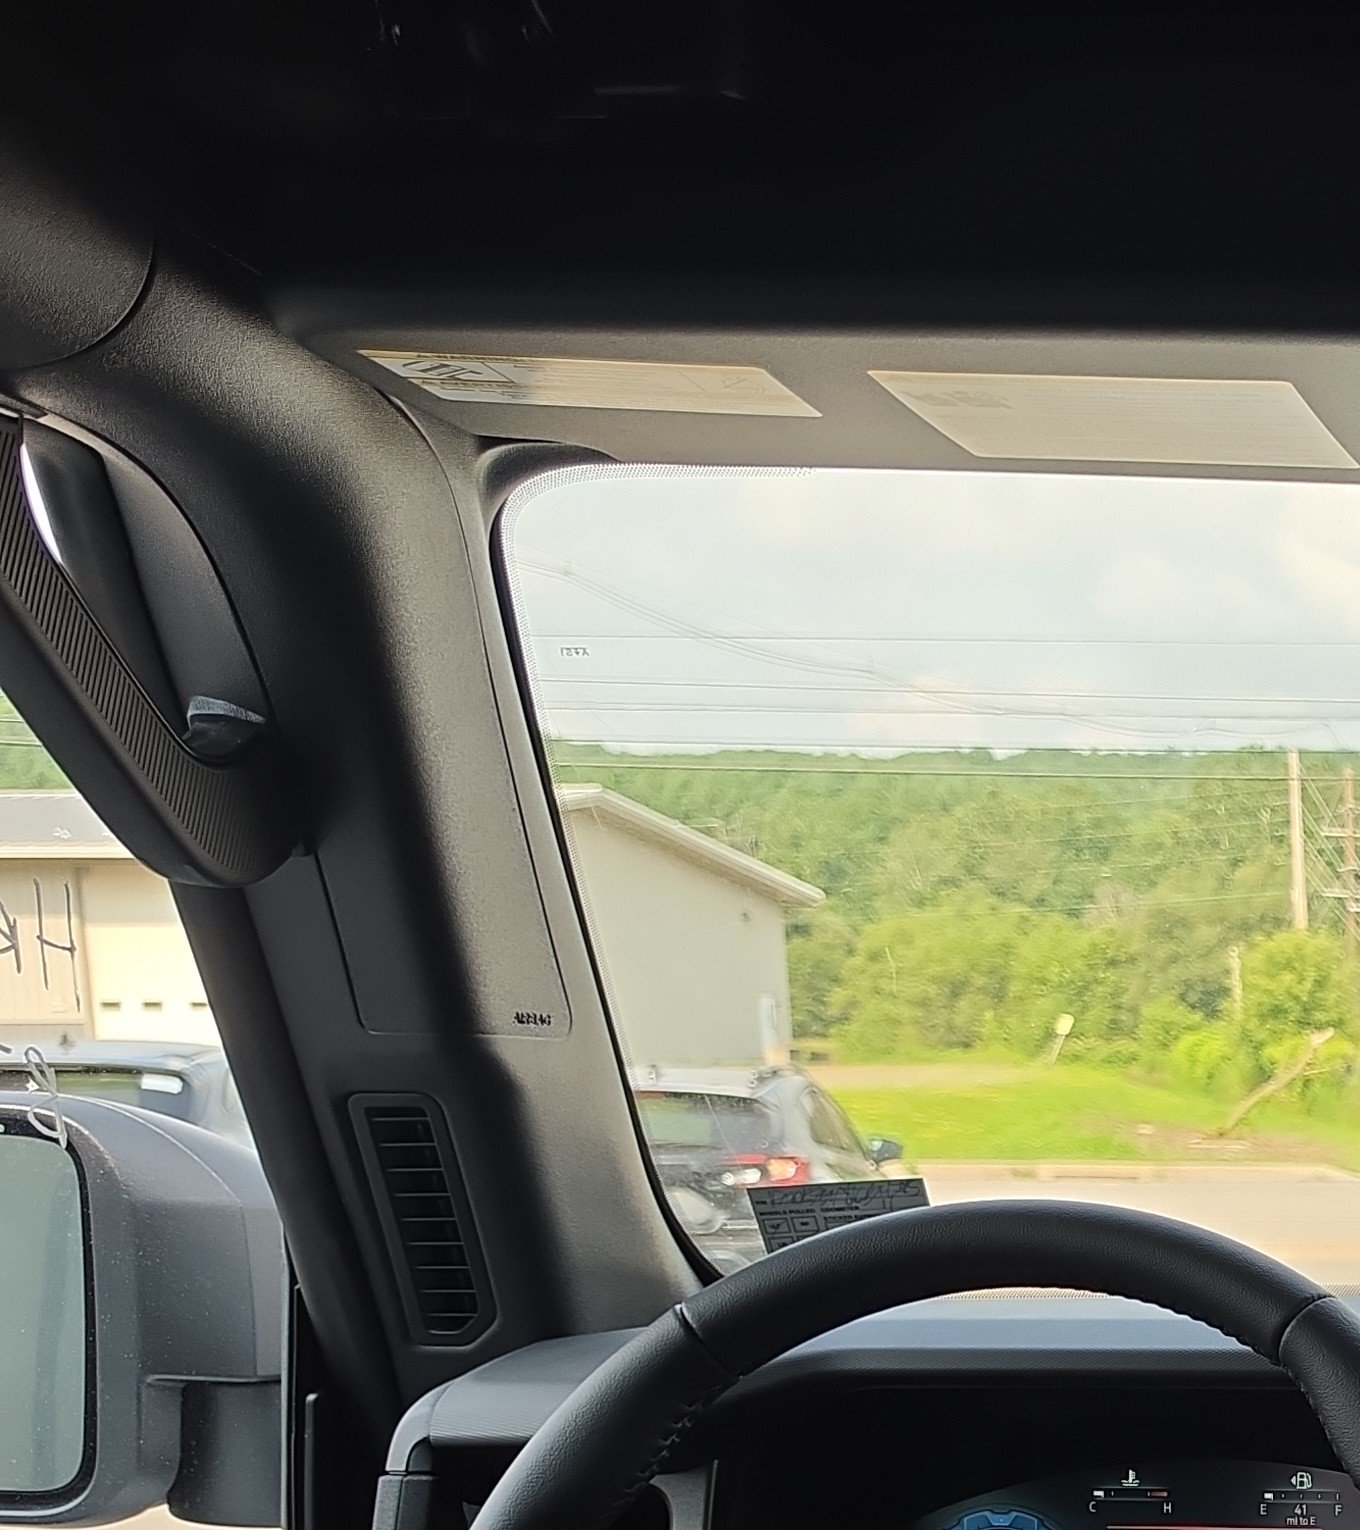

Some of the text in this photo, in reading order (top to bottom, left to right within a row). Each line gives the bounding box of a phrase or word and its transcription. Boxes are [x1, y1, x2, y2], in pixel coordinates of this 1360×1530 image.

[1089, 1502, 1096, 1513] C
[1163, 1503, 1172, 1514] H
[1260, 1504, 1267, 1516] E
[1294, 1504, 1308, 1516] 41
[1335, 1505, 1342, 1516] F
[1298, 1516, 1309, 1526] to
[1310, 1516, 1316, 1526] E
